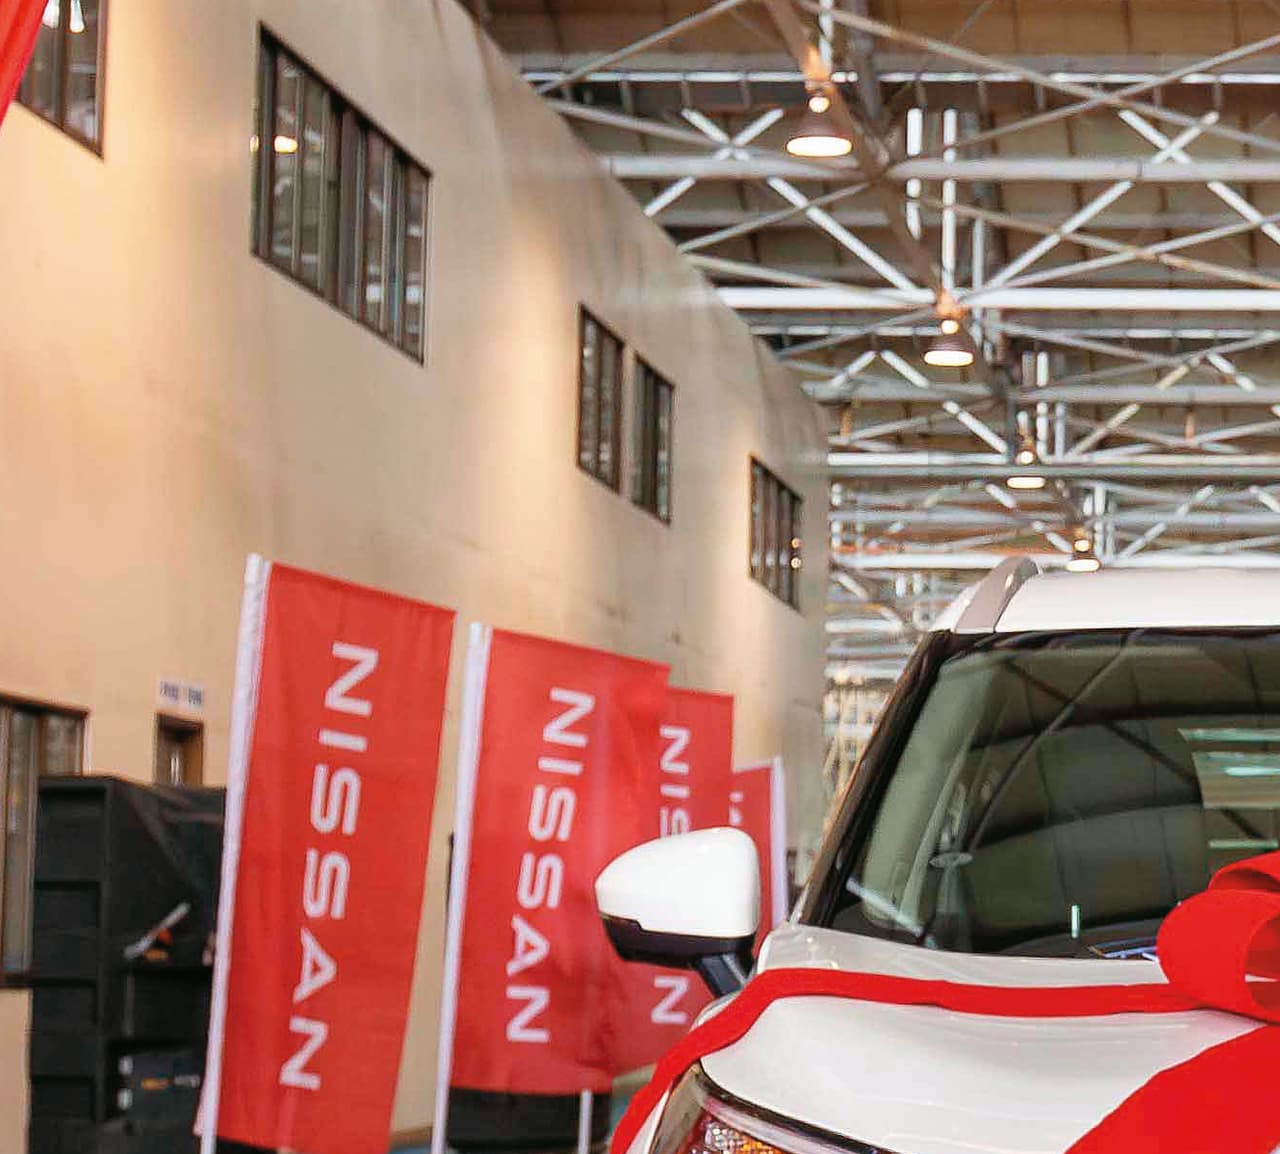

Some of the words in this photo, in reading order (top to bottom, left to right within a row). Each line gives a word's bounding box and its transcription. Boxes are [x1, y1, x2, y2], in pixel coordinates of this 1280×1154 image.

[279, 641, 380, 1091] NISSAN
[506, 687, 596, 1043] NISSAN
[651, 725, 692, 1025] NISN
